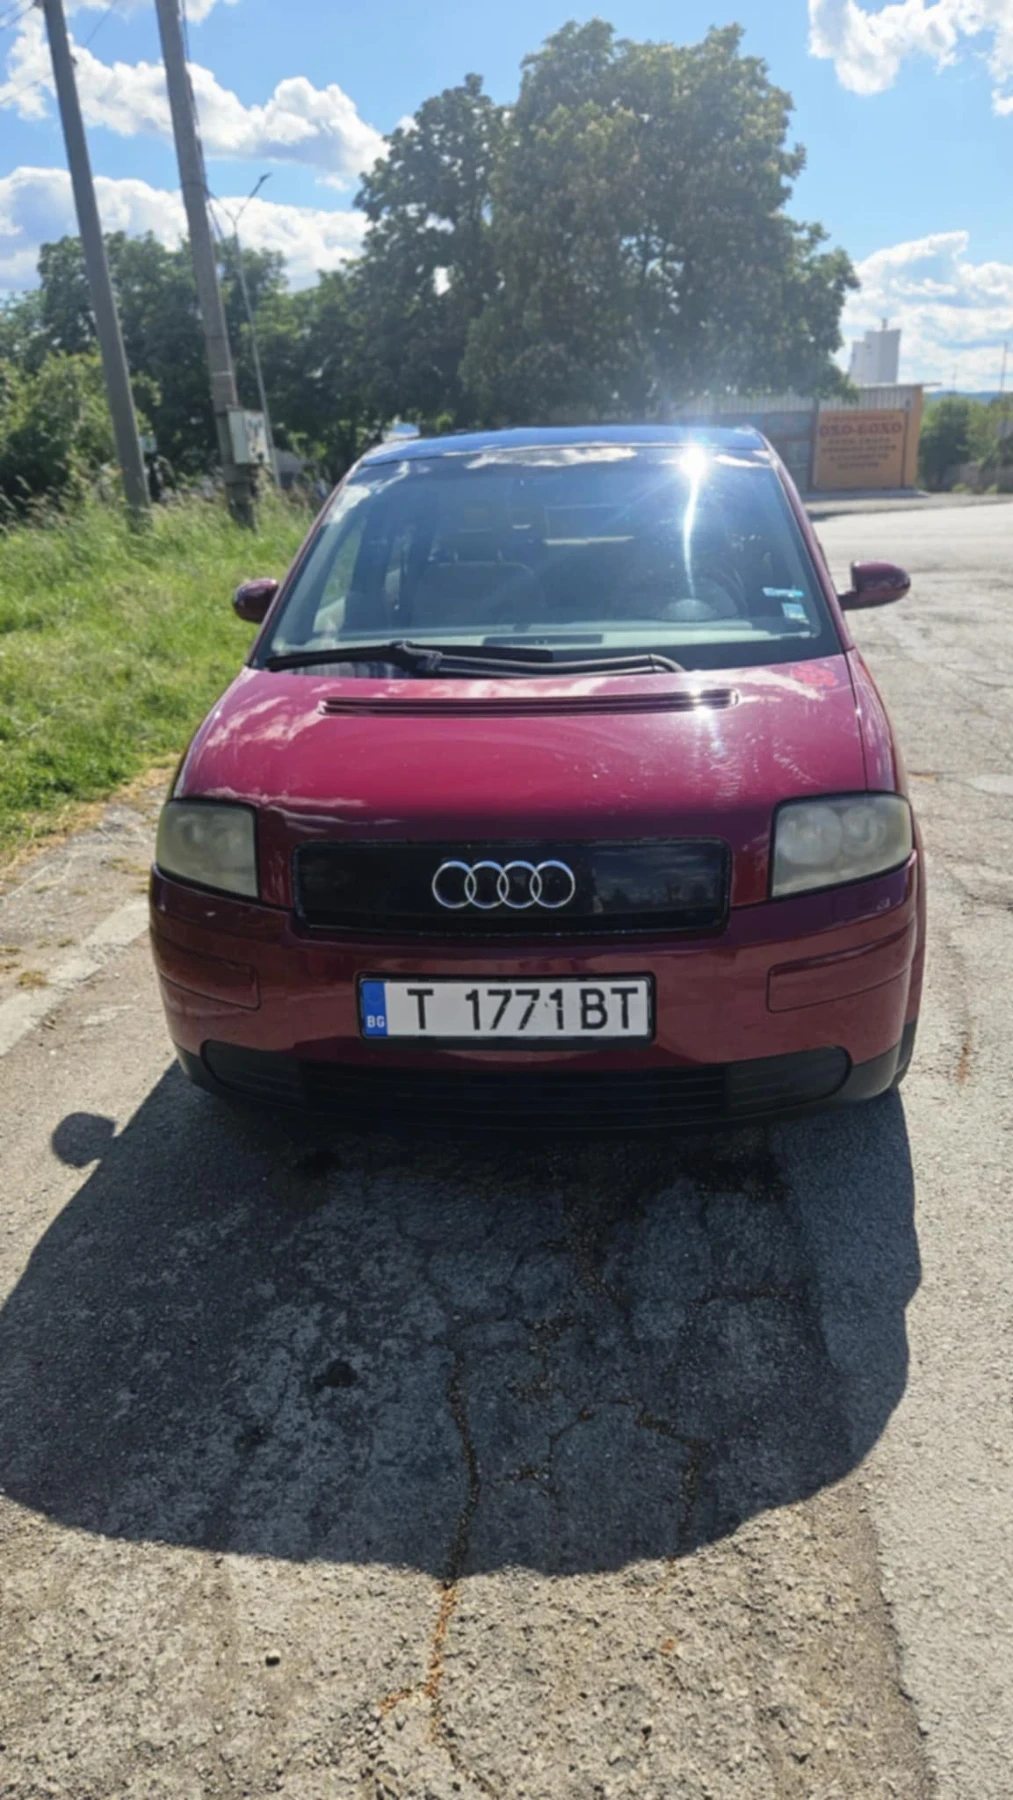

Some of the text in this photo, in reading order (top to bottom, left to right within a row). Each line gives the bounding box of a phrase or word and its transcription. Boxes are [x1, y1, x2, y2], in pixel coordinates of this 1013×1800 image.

[366, 1015, 385, 1028] BG
[407, 987, 639, 1030] T 1771 BT
